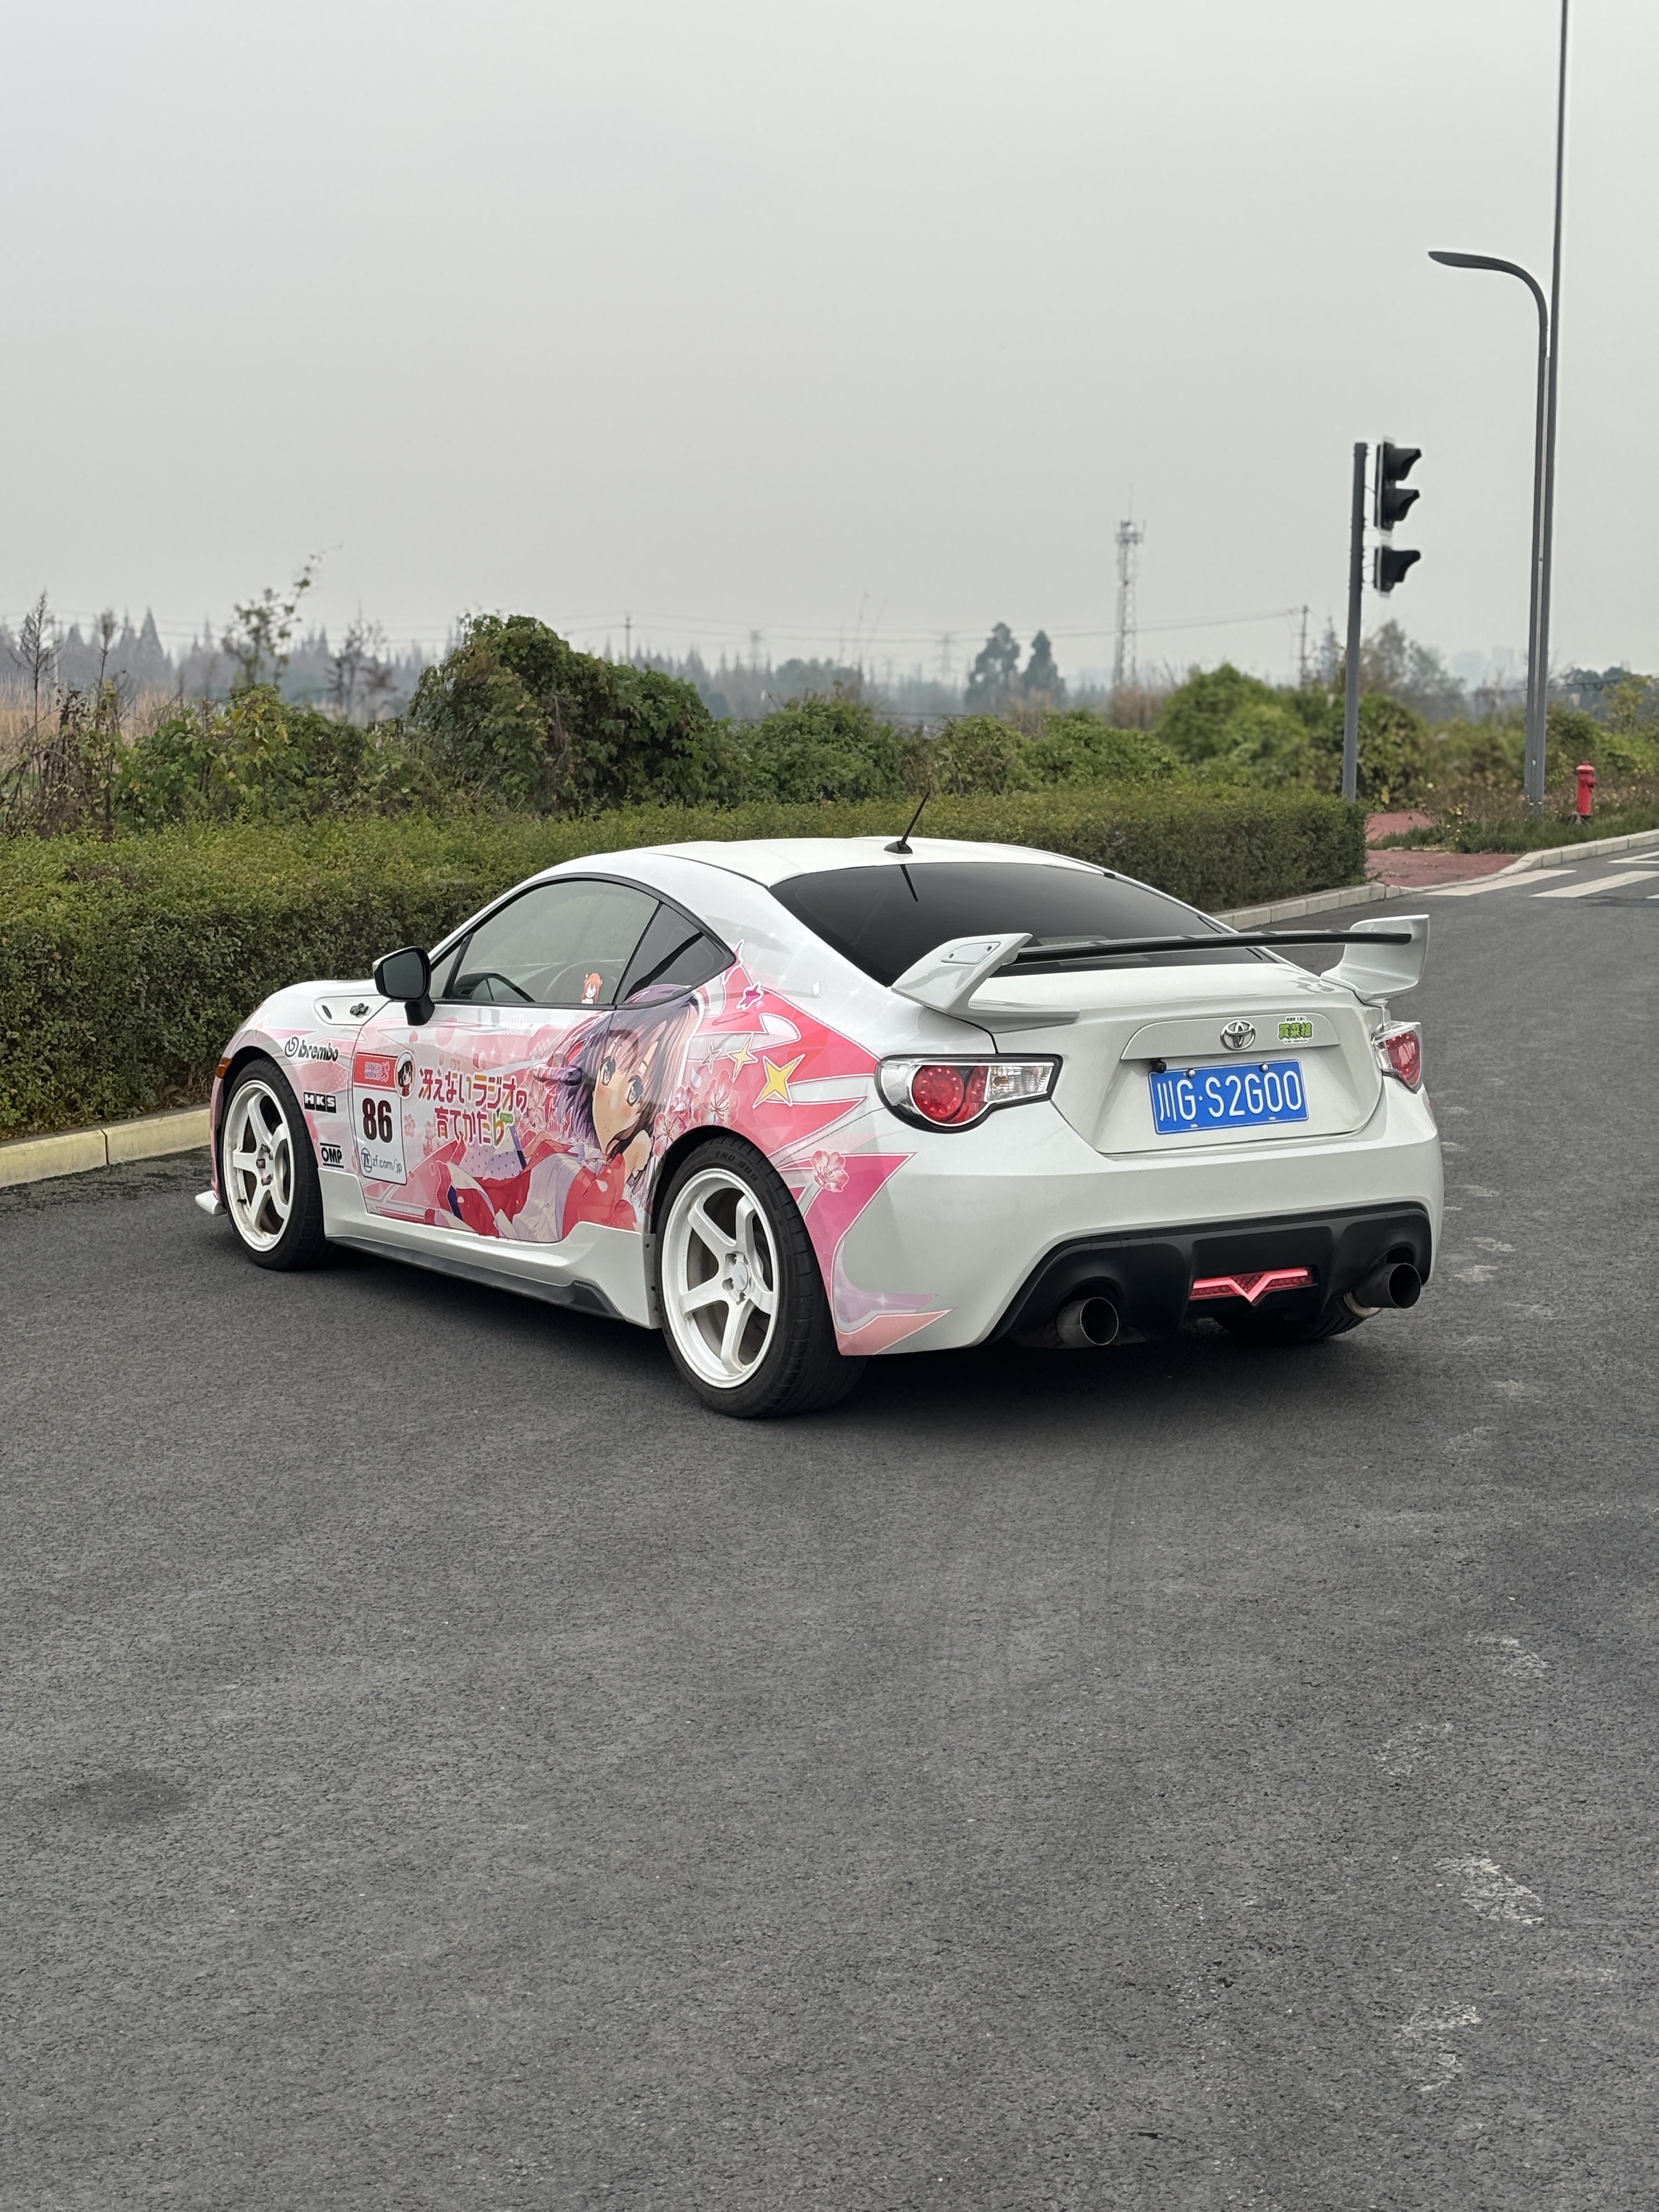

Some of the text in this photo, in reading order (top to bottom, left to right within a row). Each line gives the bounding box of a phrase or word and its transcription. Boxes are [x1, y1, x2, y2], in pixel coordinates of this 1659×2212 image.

[298, 1040, 338, 1062] brembo
[304, 1093, 335, 1108] HKS
[418, 1068, 527, 1113] 冴えないラジオの
[362, 1098, 393, 1143] 86
[321, 1147, 342, 1164] OMP
[373, 1155, 403, 1173] zf.com/jp
